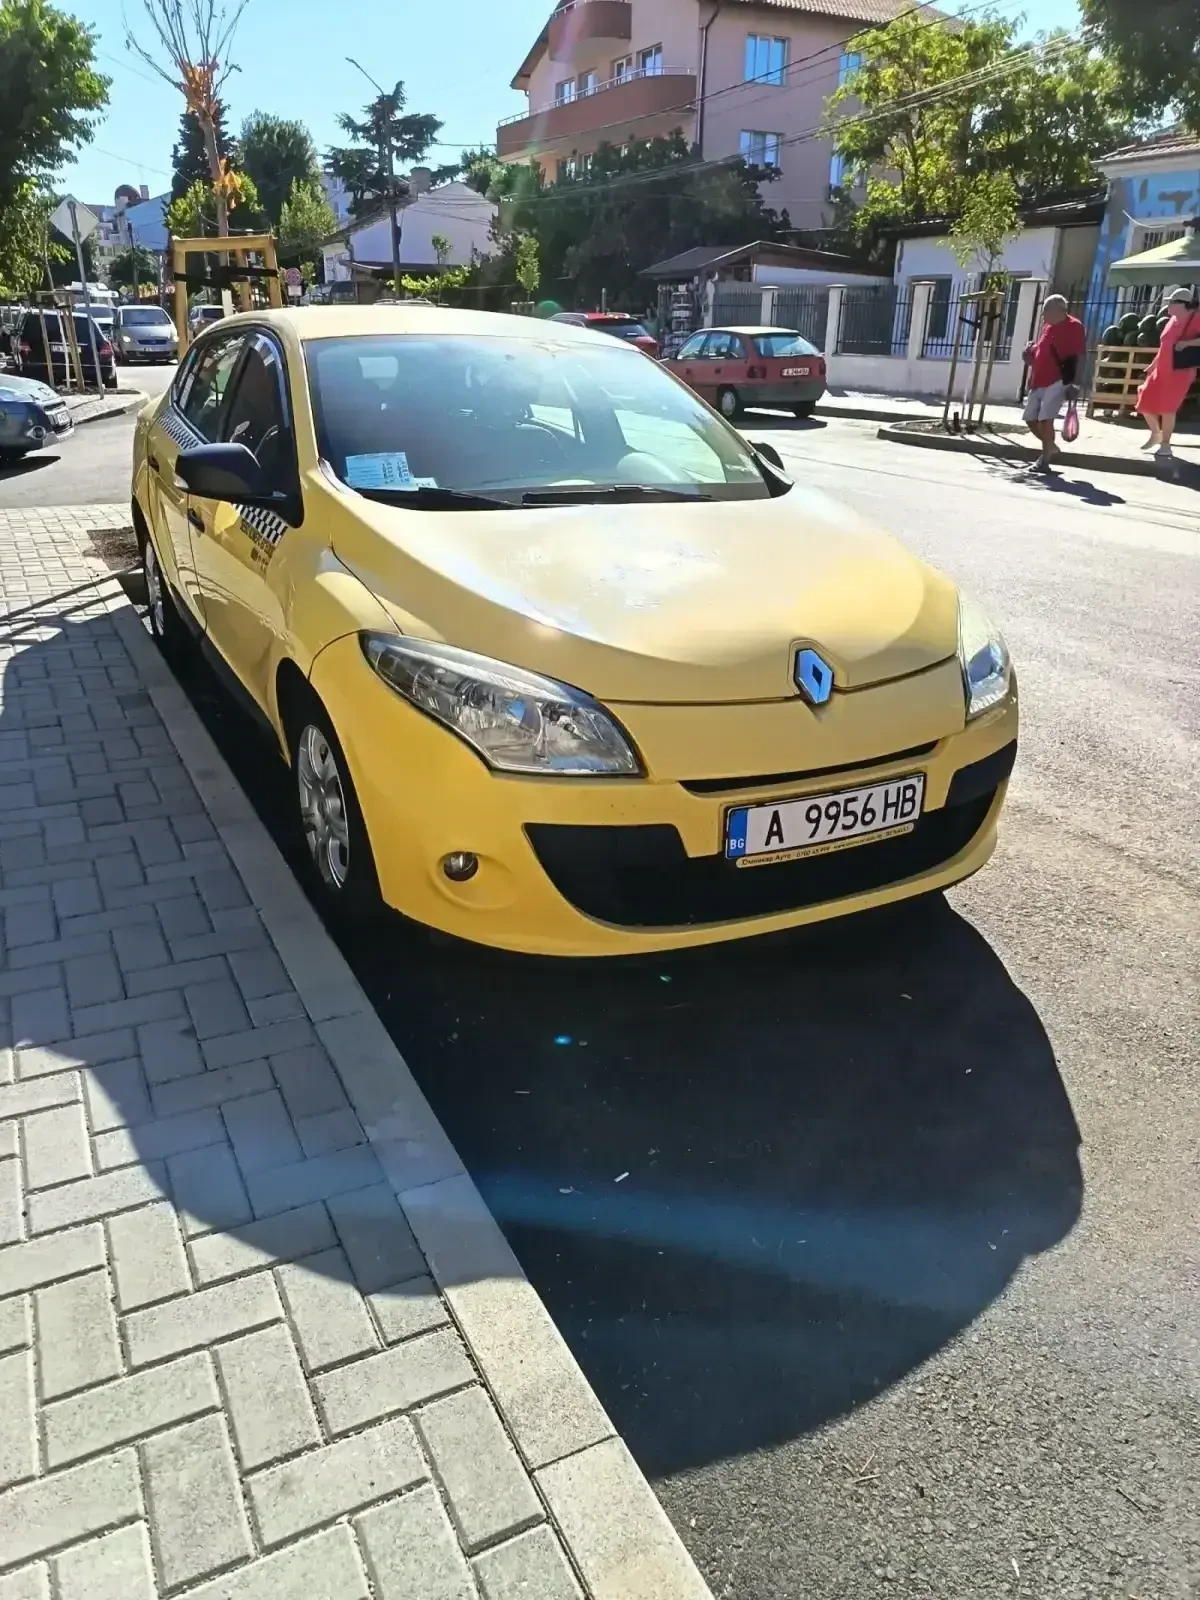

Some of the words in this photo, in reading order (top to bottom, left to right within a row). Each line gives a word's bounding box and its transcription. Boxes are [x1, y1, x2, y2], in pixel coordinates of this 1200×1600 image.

[764, 809, 785, 847] A
[805, 793, 877, 840] 9956
[881, 783, 917, 823] HB
[730, 838, 745, 850] BG
